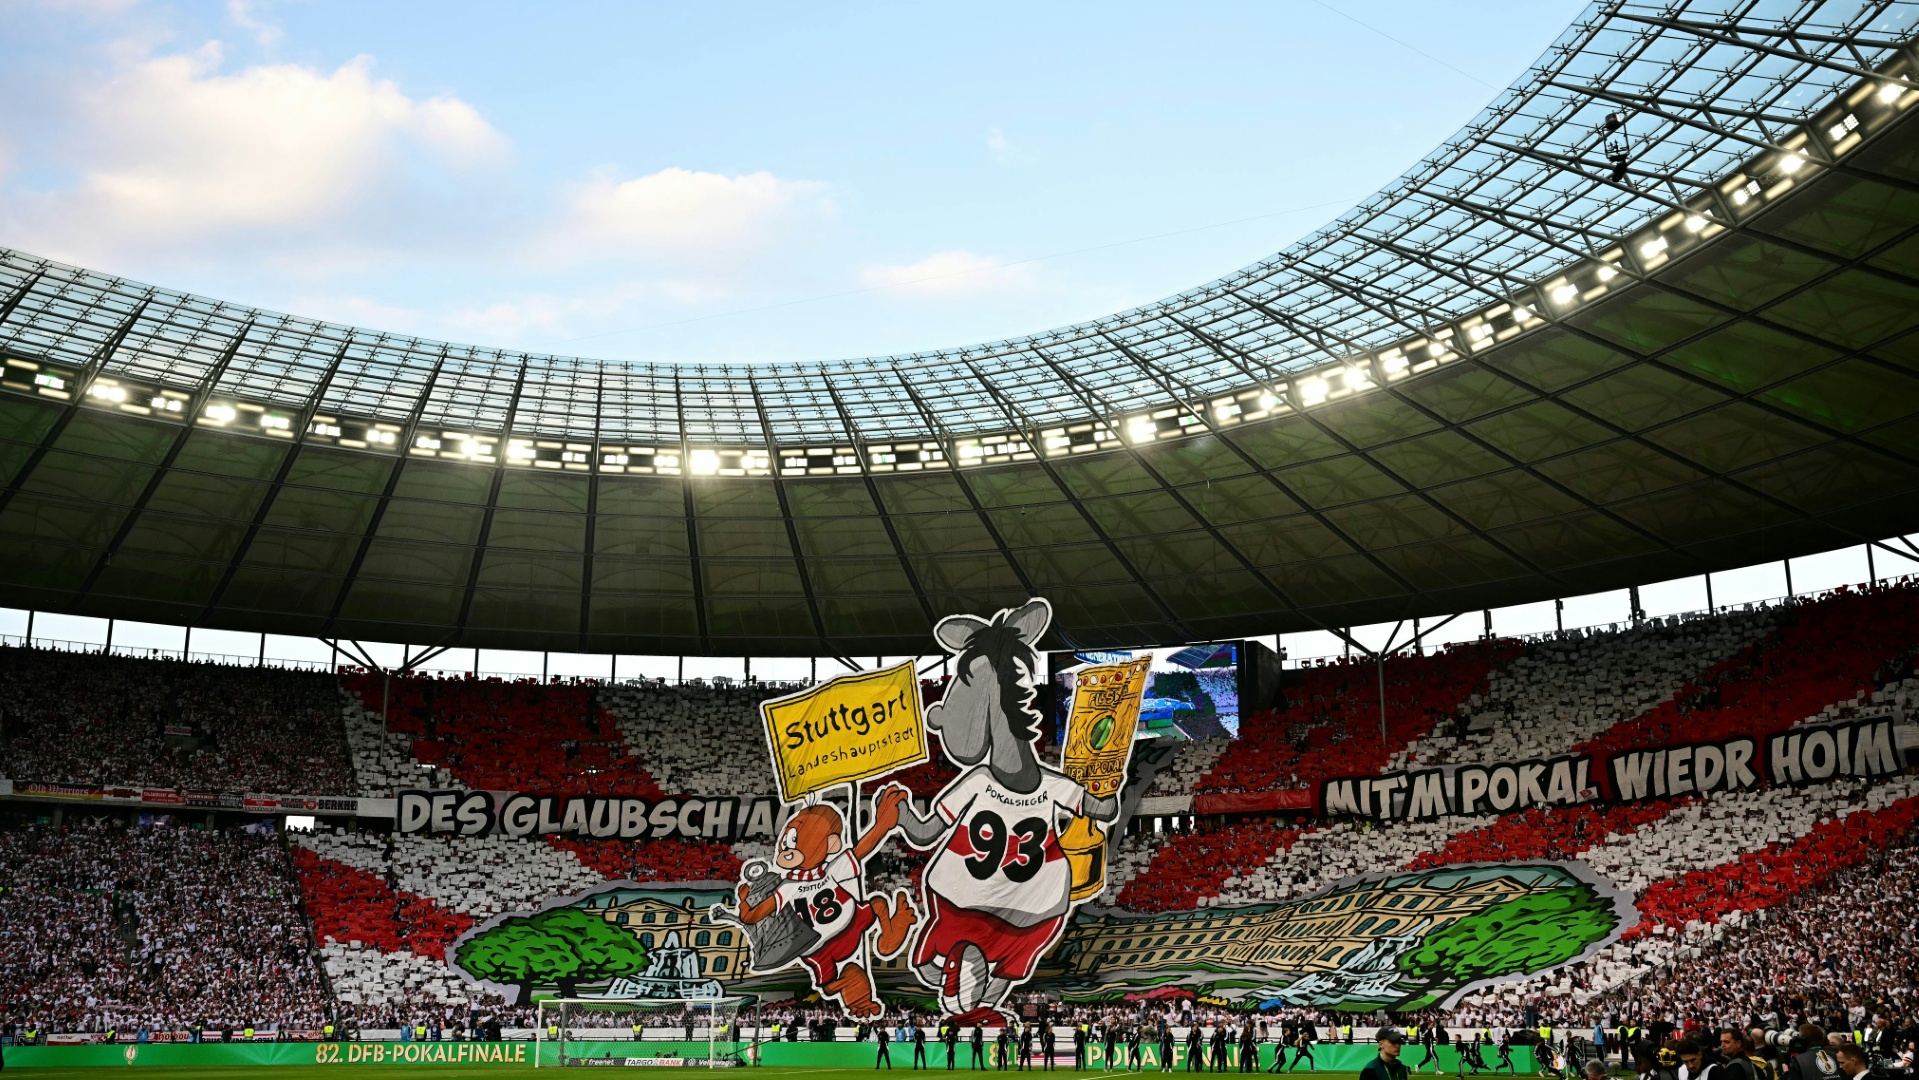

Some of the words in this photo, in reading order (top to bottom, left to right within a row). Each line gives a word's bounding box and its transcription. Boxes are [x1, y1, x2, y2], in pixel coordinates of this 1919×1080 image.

[785, 689, 907, 749] Stuttgart
[787, 726, 915, 778] Landeshauptstadt
[1461, 758, 1600, 814] POKAL
[1612, 738, 1757, 801] WIEDR
[1771, 721, 1898, 784] HOIM
[28, 783, 46, 793] Old
[48, 784, 89, 796] Warriors
[985, 784, 1048, 807] POKALSIEGER
[400, 793, 488, 836] DES
[502, 795, 733, 839] GLAUBSCH
[964, 809, 1048, 883] 93
[794, 887, 843, 928] 18
[315, 1043, 343, 1064] 82.
[348, 1043, 526, 1064] DFB-POKALFINALE
[588, 1058, 615, 1066] freenet
